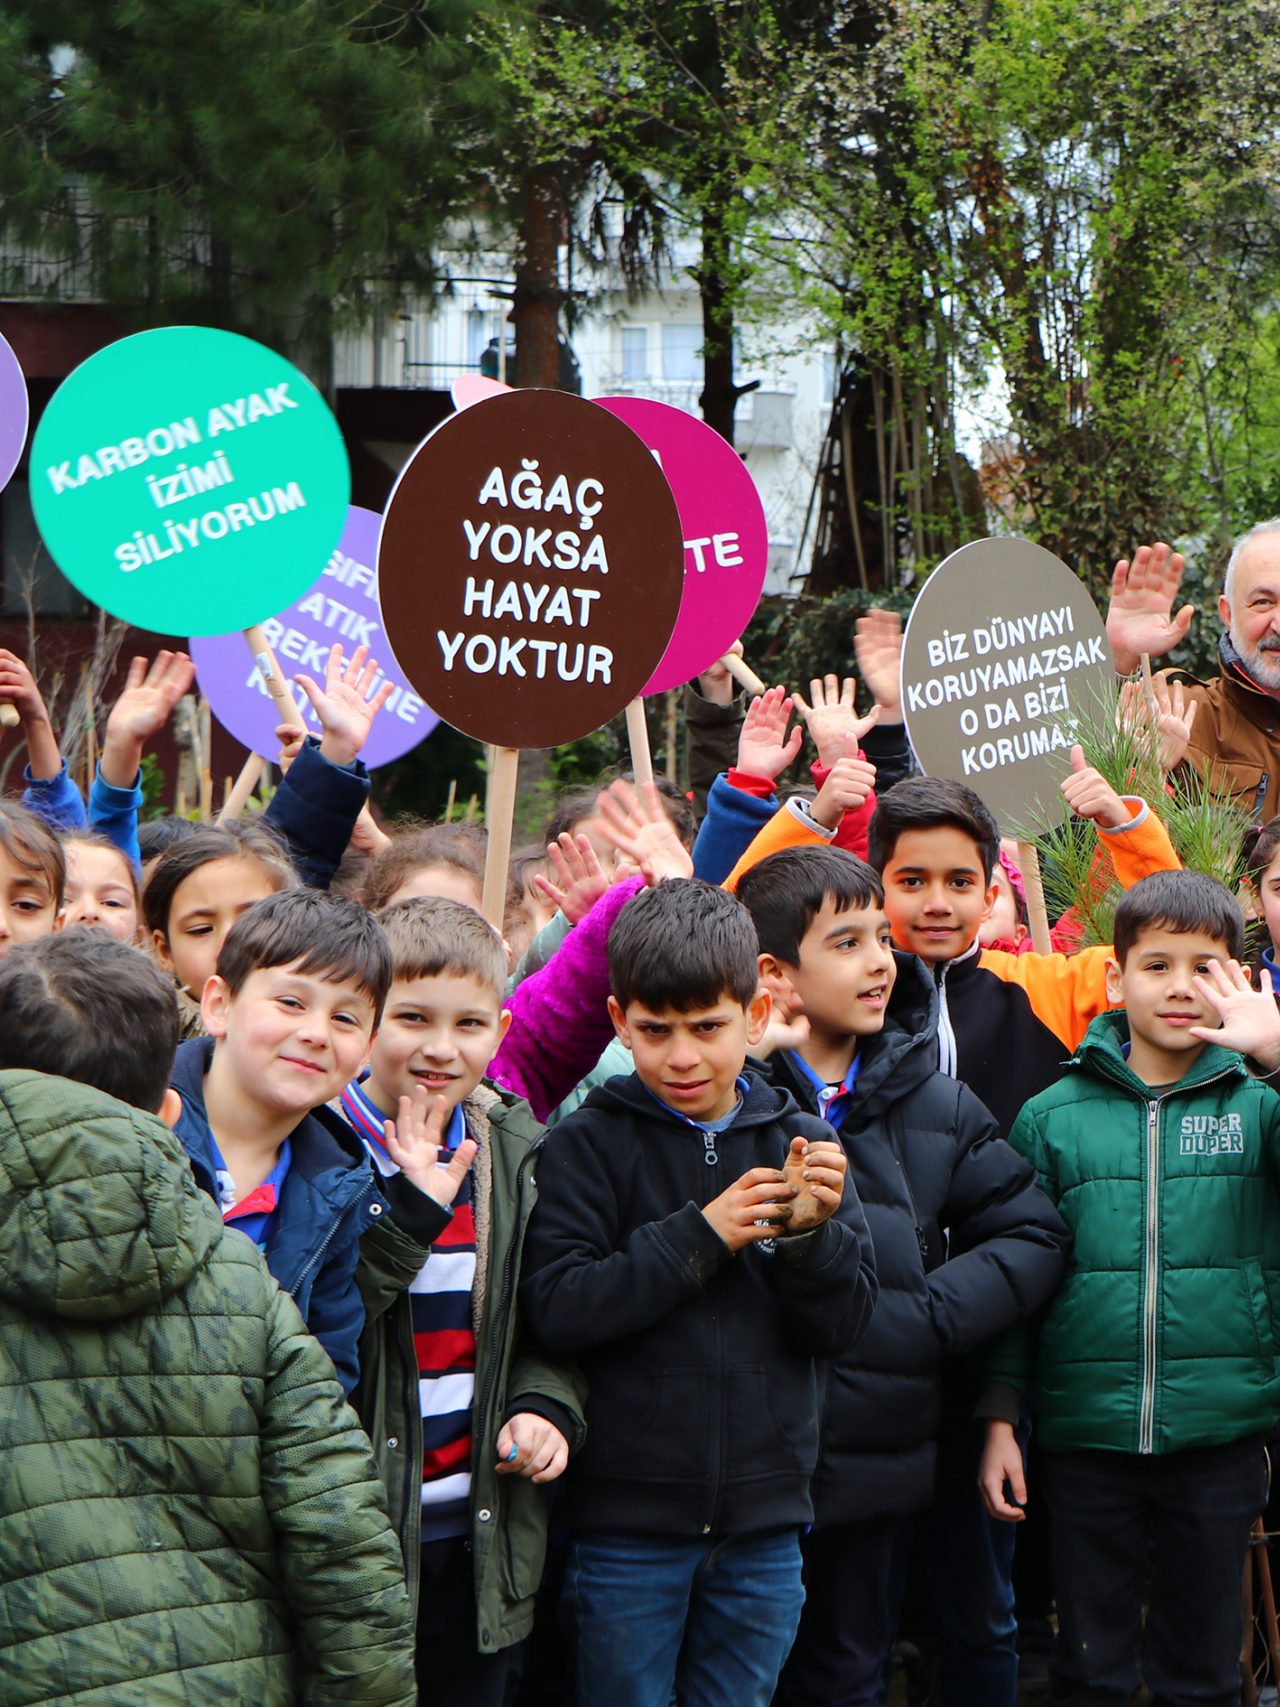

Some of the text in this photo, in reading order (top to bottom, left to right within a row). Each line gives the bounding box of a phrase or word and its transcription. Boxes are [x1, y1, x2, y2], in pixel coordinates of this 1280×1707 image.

[47, 382, 299, 494] KARBON AYAK
[145, 449, 234, 509] İZİMİ
[478, 458, 605, 530] AĞAÇ
[114, 481, 307, 573] SİLİYORUM
[463, 519, 609, 574] YOKSA
[683, 532, 744, 574] TE
[321, 549, 378, 602] SIFI
[463, 576, 601, 627] HAYAT
[297, 592, 379, 648] ATIK
[927, 606, 1074, 668] BİZ DÜNYAYI
[437, 629, 614, 685] YOKTUR
[906, 636, 1106, 713] KORUYAMAZSAK
[960, 677, 1070, 736] O DA BİZİ
[1181, 1133, 1243, 1156] DUPER
[1182, 1113, 1242, 1135] SUPER
